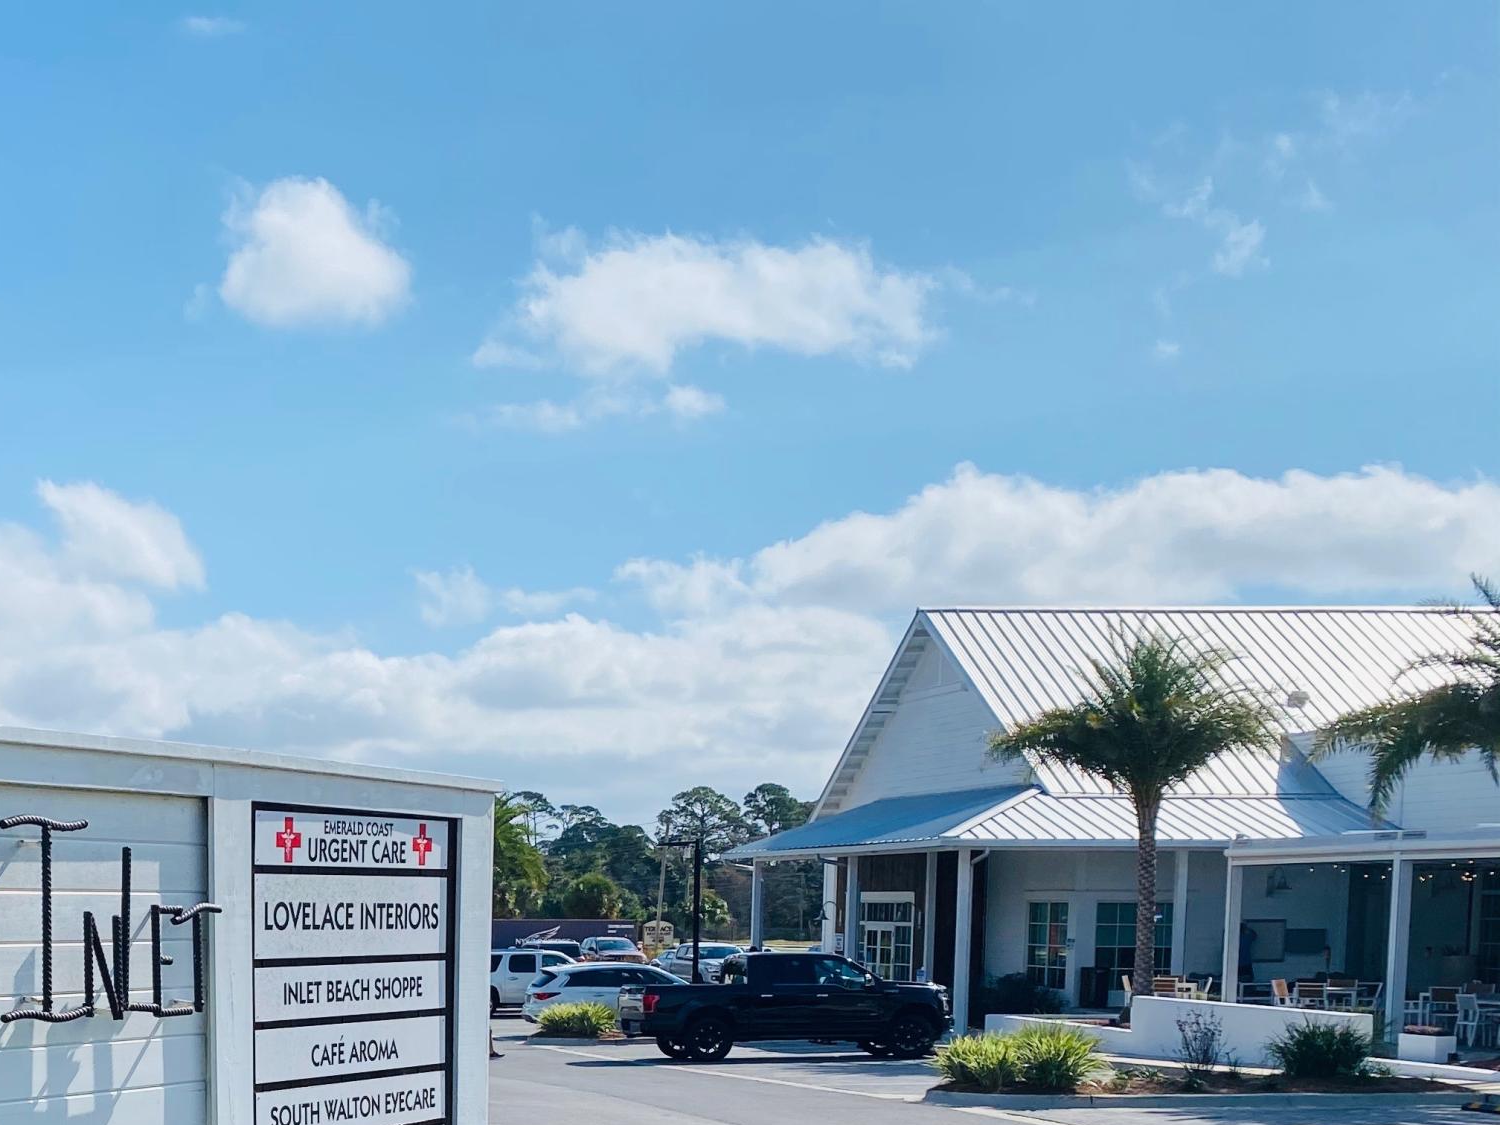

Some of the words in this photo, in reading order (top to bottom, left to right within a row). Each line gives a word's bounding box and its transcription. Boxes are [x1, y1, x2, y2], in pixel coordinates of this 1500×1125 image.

[323, 819, 363, 836] EMERALD
[365, 821, 394, 837] COAST
[307, 837, 367, 863] URGENT
[371, 839, 407, 864] CARE
[264, 901, 355, 931] LOVELACE
[359, 902, 439, 930] INTERIORS
[283, 980, 322, 1006] INLET
[326, 978, 370, 1003] BEACH
[374, 975, 423, 999] SHOPPE
[311, 1034, 345, 1067] CAFÉ
[348, 1038, 399, 1064] AROMA
[323, 1094, 381, 1122] WALTON
[384, 1087, 436, 1115] EYECARE
